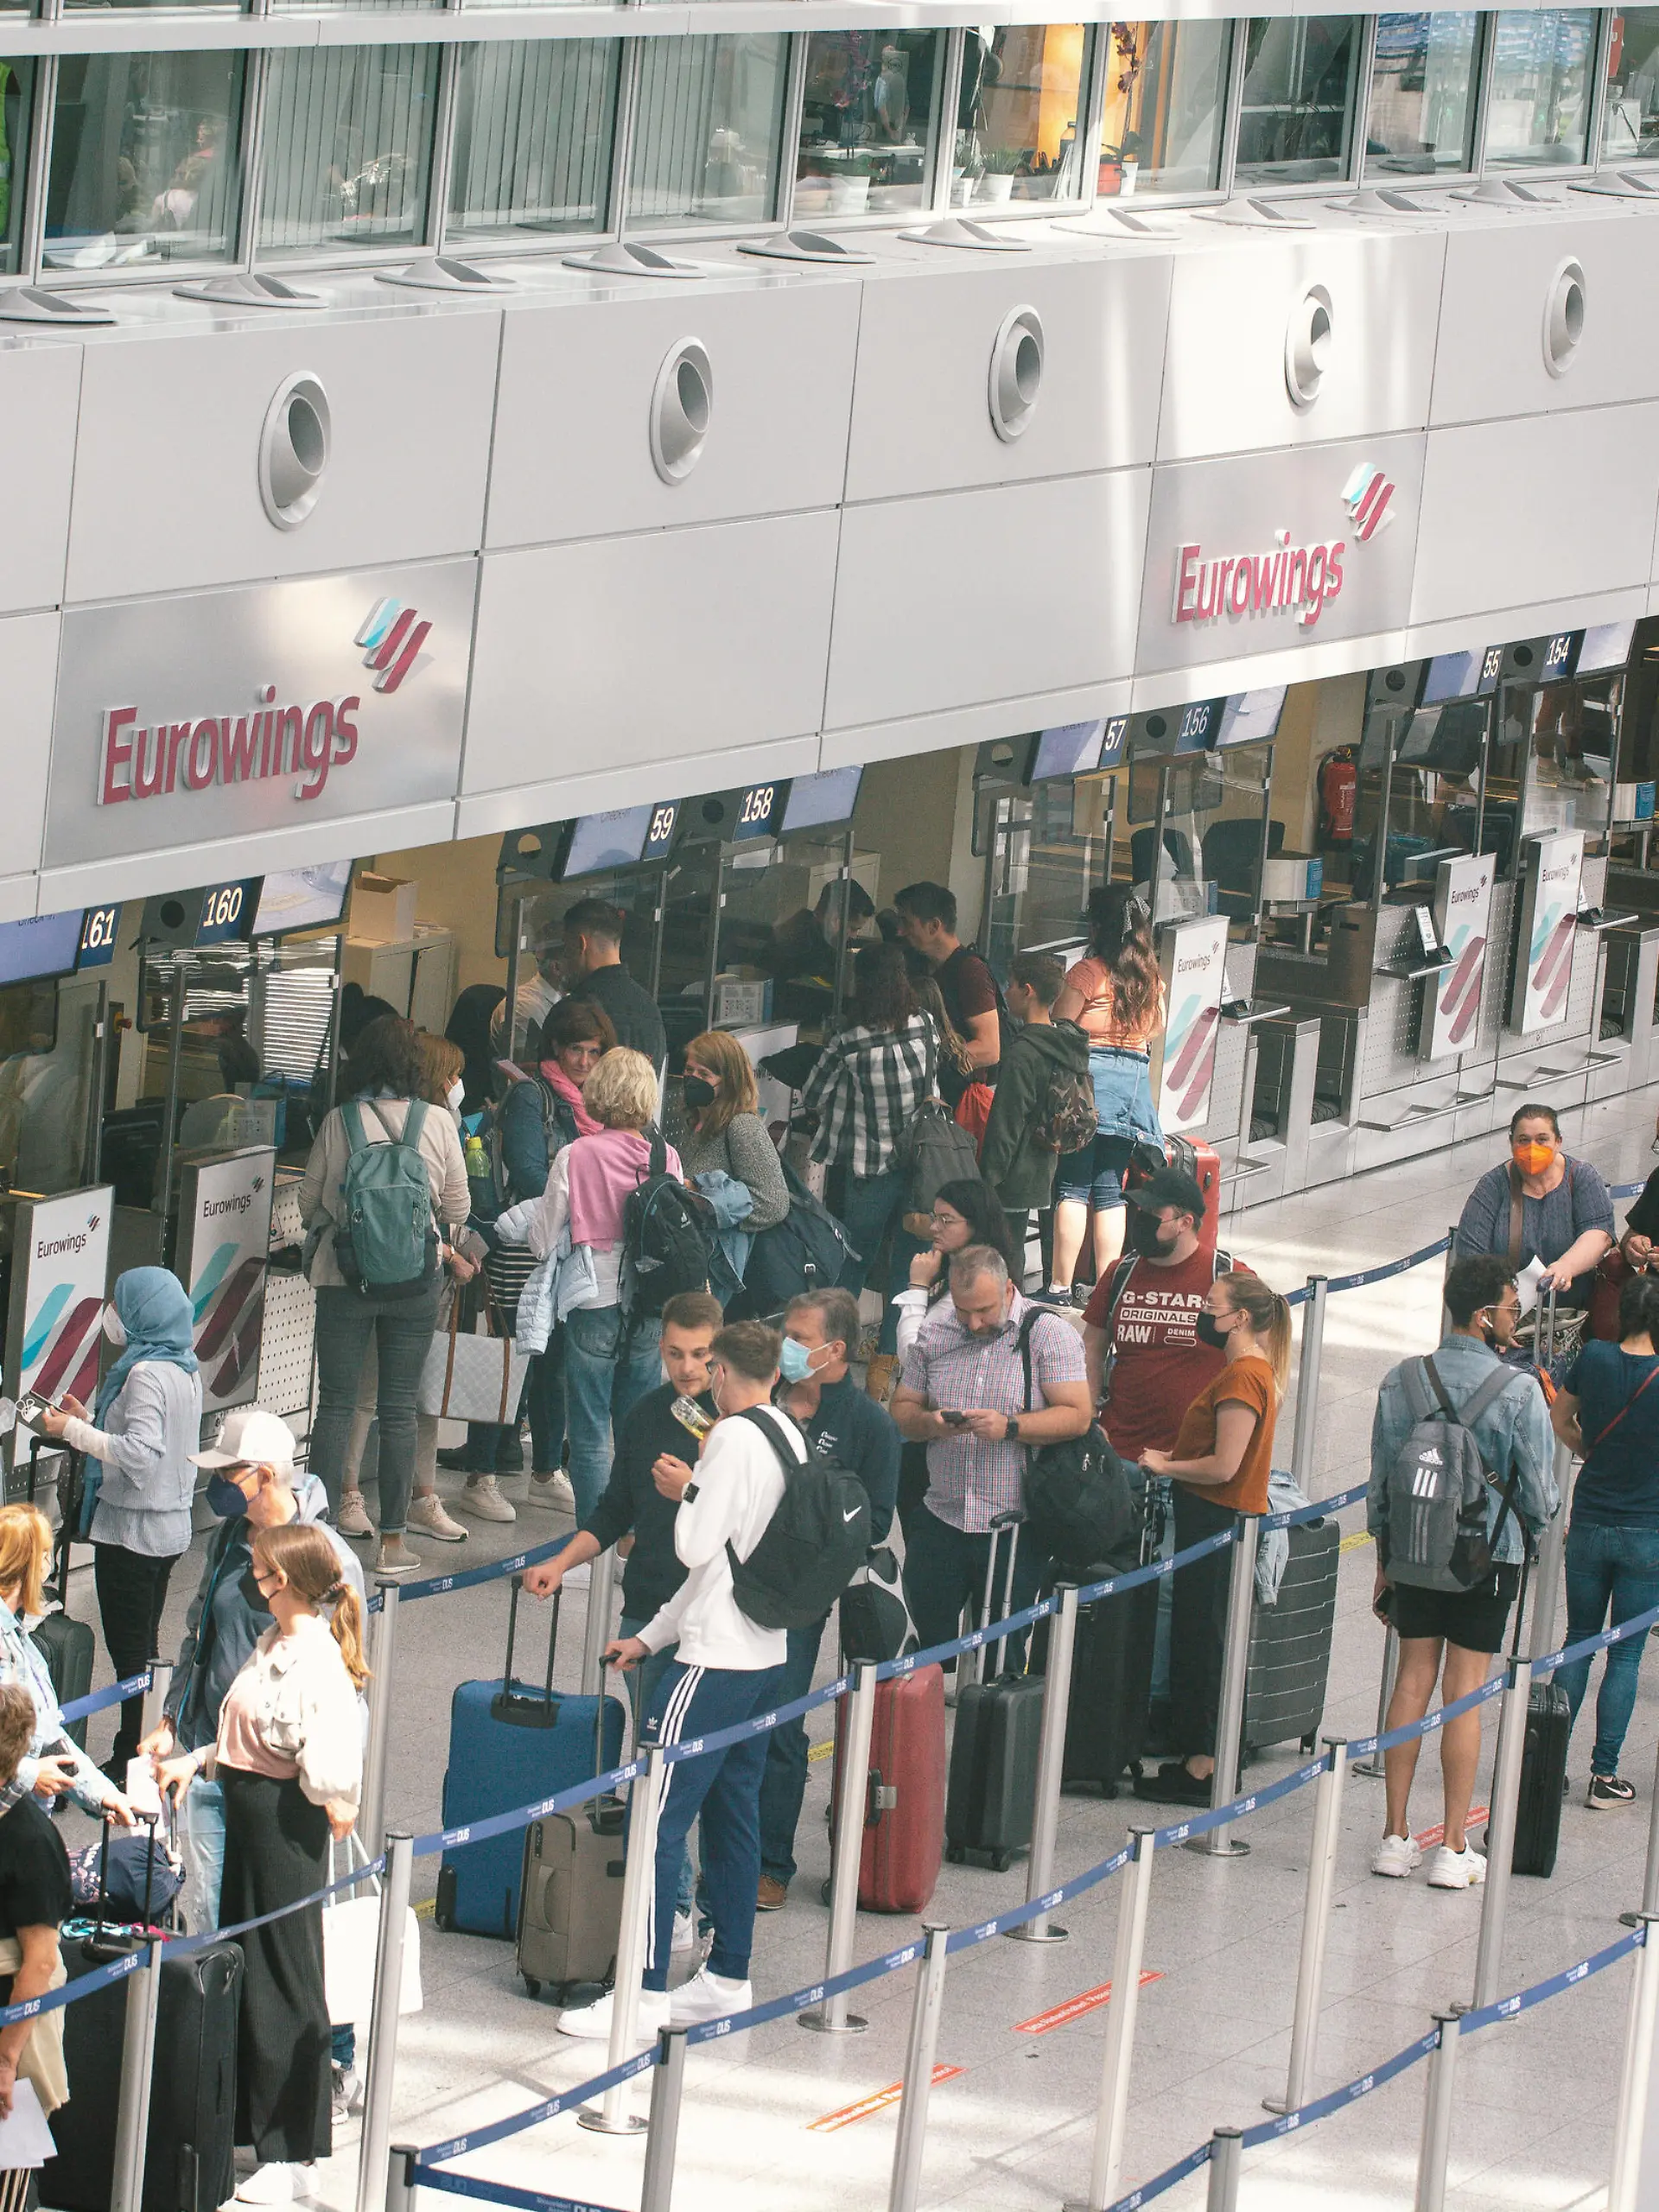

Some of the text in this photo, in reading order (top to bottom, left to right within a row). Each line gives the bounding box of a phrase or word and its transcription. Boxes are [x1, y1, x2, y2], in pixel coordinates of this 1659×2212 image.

[1172, 529, 1345, 626] Eurowings
[1546, 636, 1571, 666] 154
[1181, 705, 1211, 737] 156
[98, 683, 360, 804] Eurowings
[741, 786, 774, 823] 158
[1541, 865, 1569, 882] Eurowings
[1451, 887, 1479, 904] Eurowings
[203, 887, 243, 927] 160
[1178, 954, 1211, 973] Eurowings
[203, 1194, 251, 1217] Eurowings
[37, 1234, 86, 1259] Eurowings
[1122, 1291, 1202, 1308] G-STAR
[1122, 1309, 1196, 1324] ORIGINALS
[1117, 1325, 1195, 1344] RAW DENIM
[137, 1674, 150, 1690] DUS
[624, 1764, 638, 1779] DUS
[542, 1798, 556, 1815] DUS
[456, 1827, 471, 1842] DUS
[124, 1955, 138, 1971] DUS
[24, 1999, 41, 2017] DUS
[716, 2019, 731, 2036] DUS
